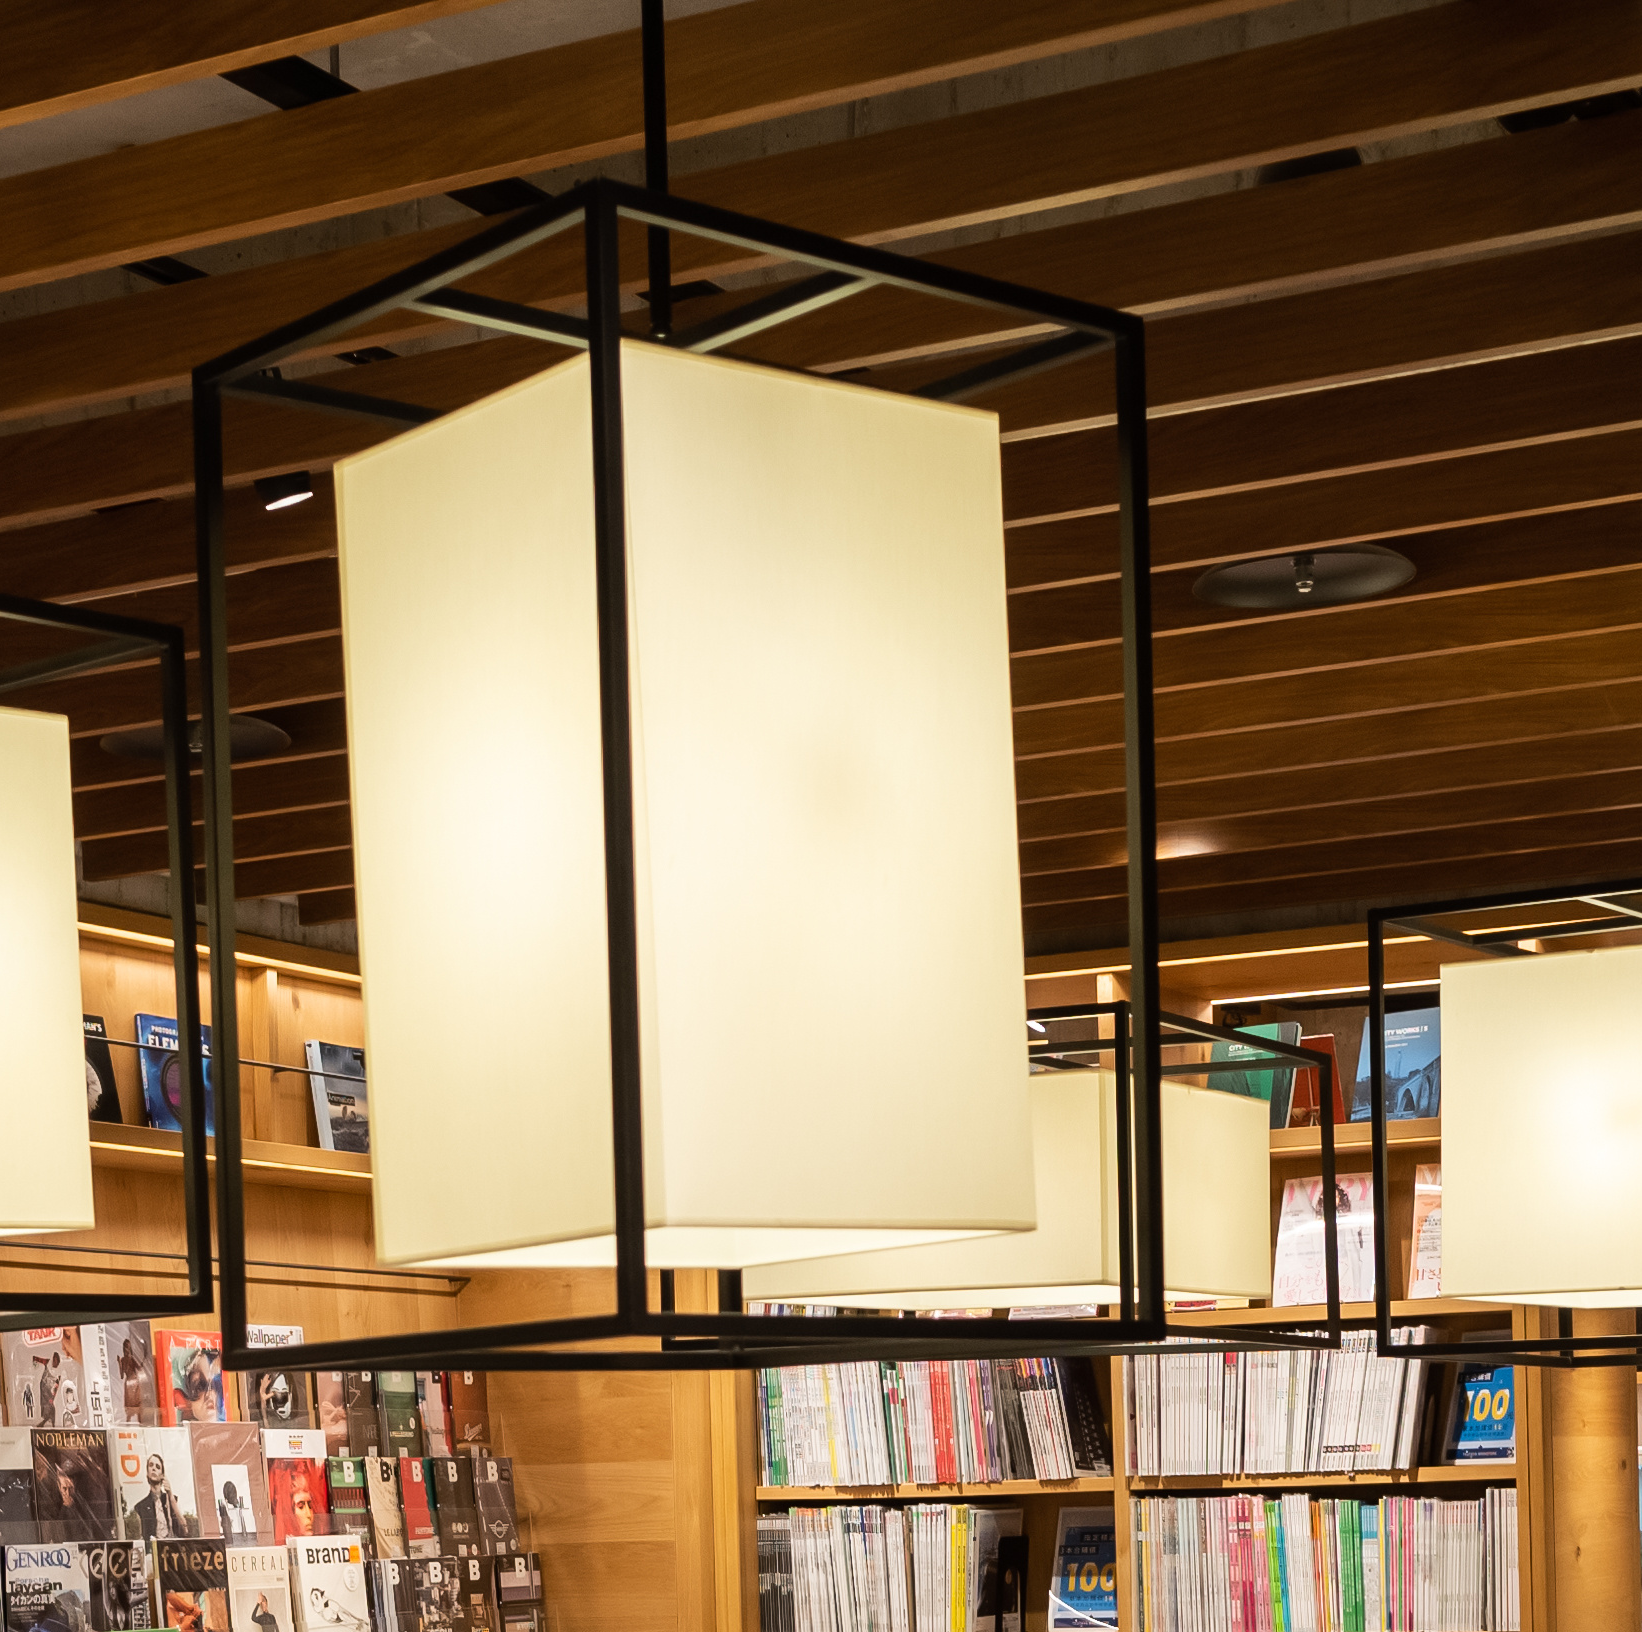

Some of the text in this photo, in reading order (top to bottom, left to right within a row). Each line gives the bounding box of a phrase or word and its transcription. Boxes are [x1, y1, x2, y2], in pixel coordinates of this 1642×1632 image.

[35, 1431, 105, 1448] NOBLEMAN
[163, 1549, 225, 1572] frieze
[231, 1555, 285, 1572] CEREAL
